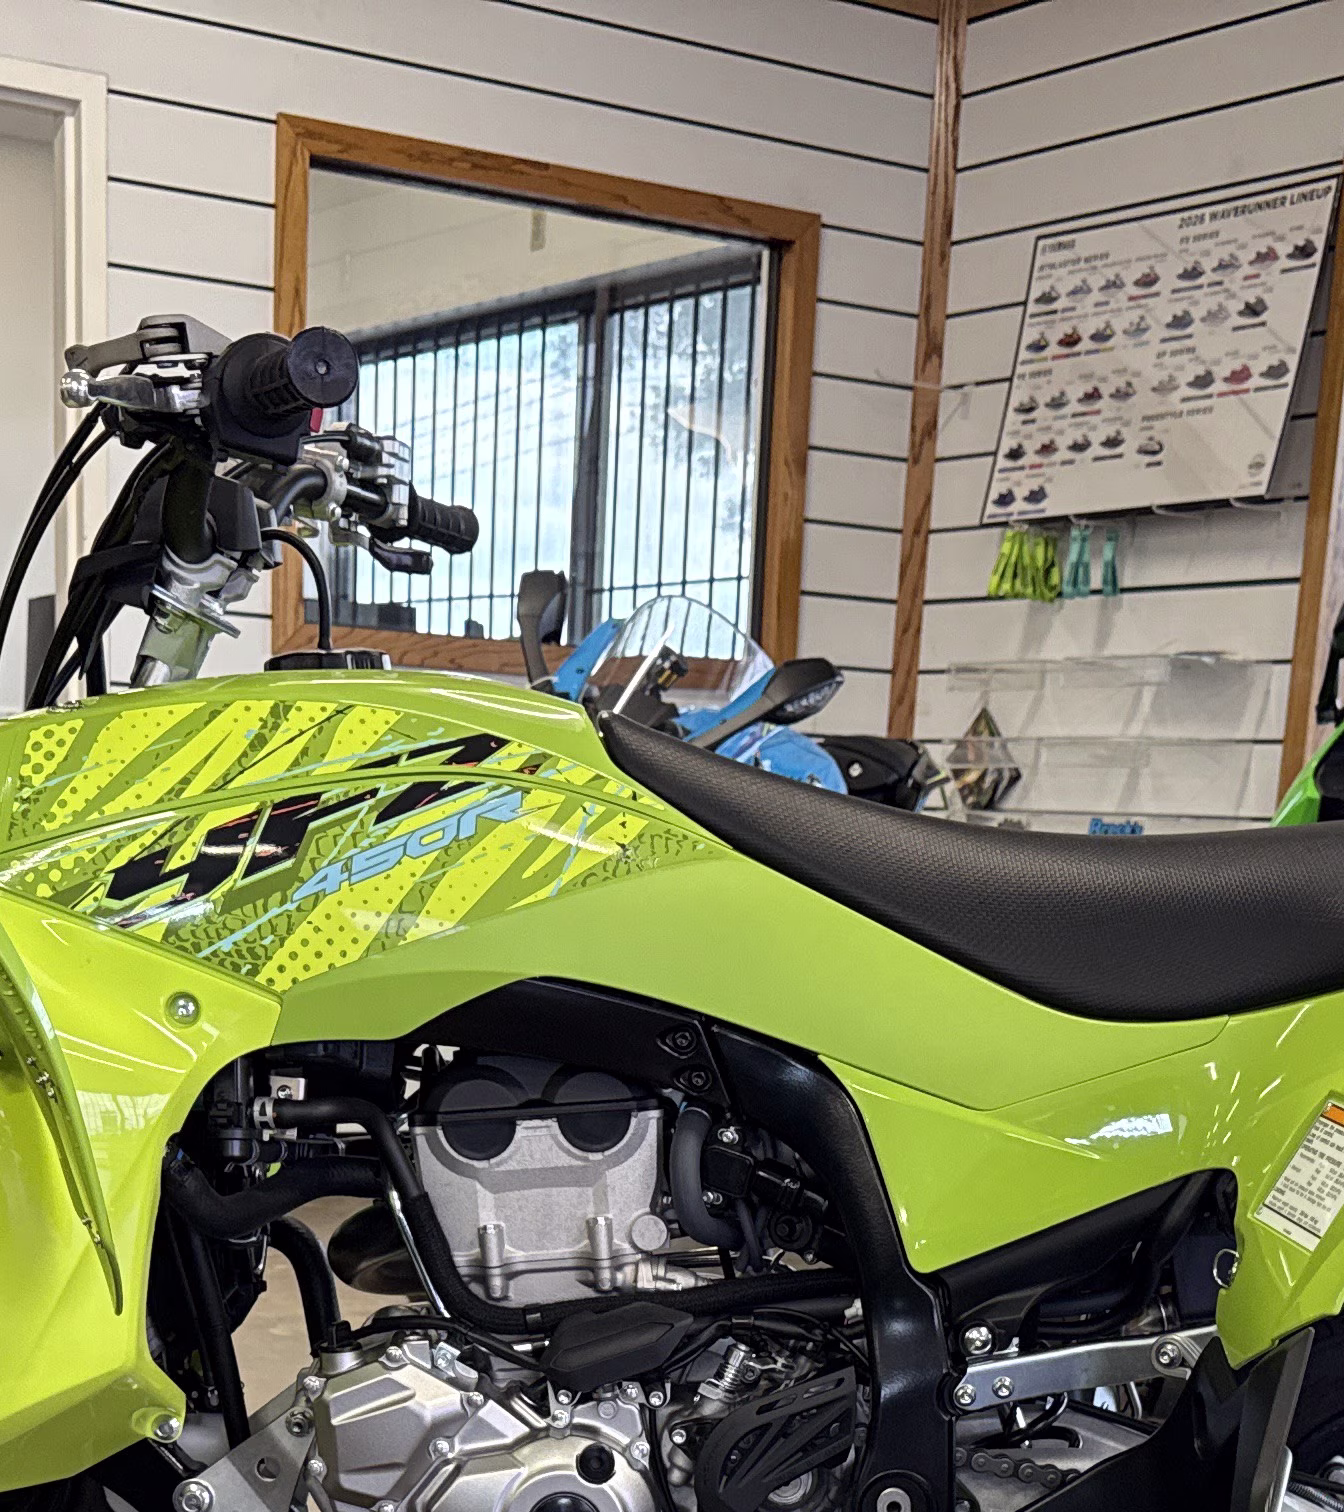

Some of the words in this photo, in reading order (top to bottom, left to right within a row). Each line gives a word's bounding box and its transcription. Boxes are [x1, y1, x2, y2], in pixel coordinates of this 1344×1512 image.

[1208, 196, 1287, 224] WAVERUNNER
[1289, 185, 1333, 207] LINEUP
[291, 790, 526, 903] 450R
